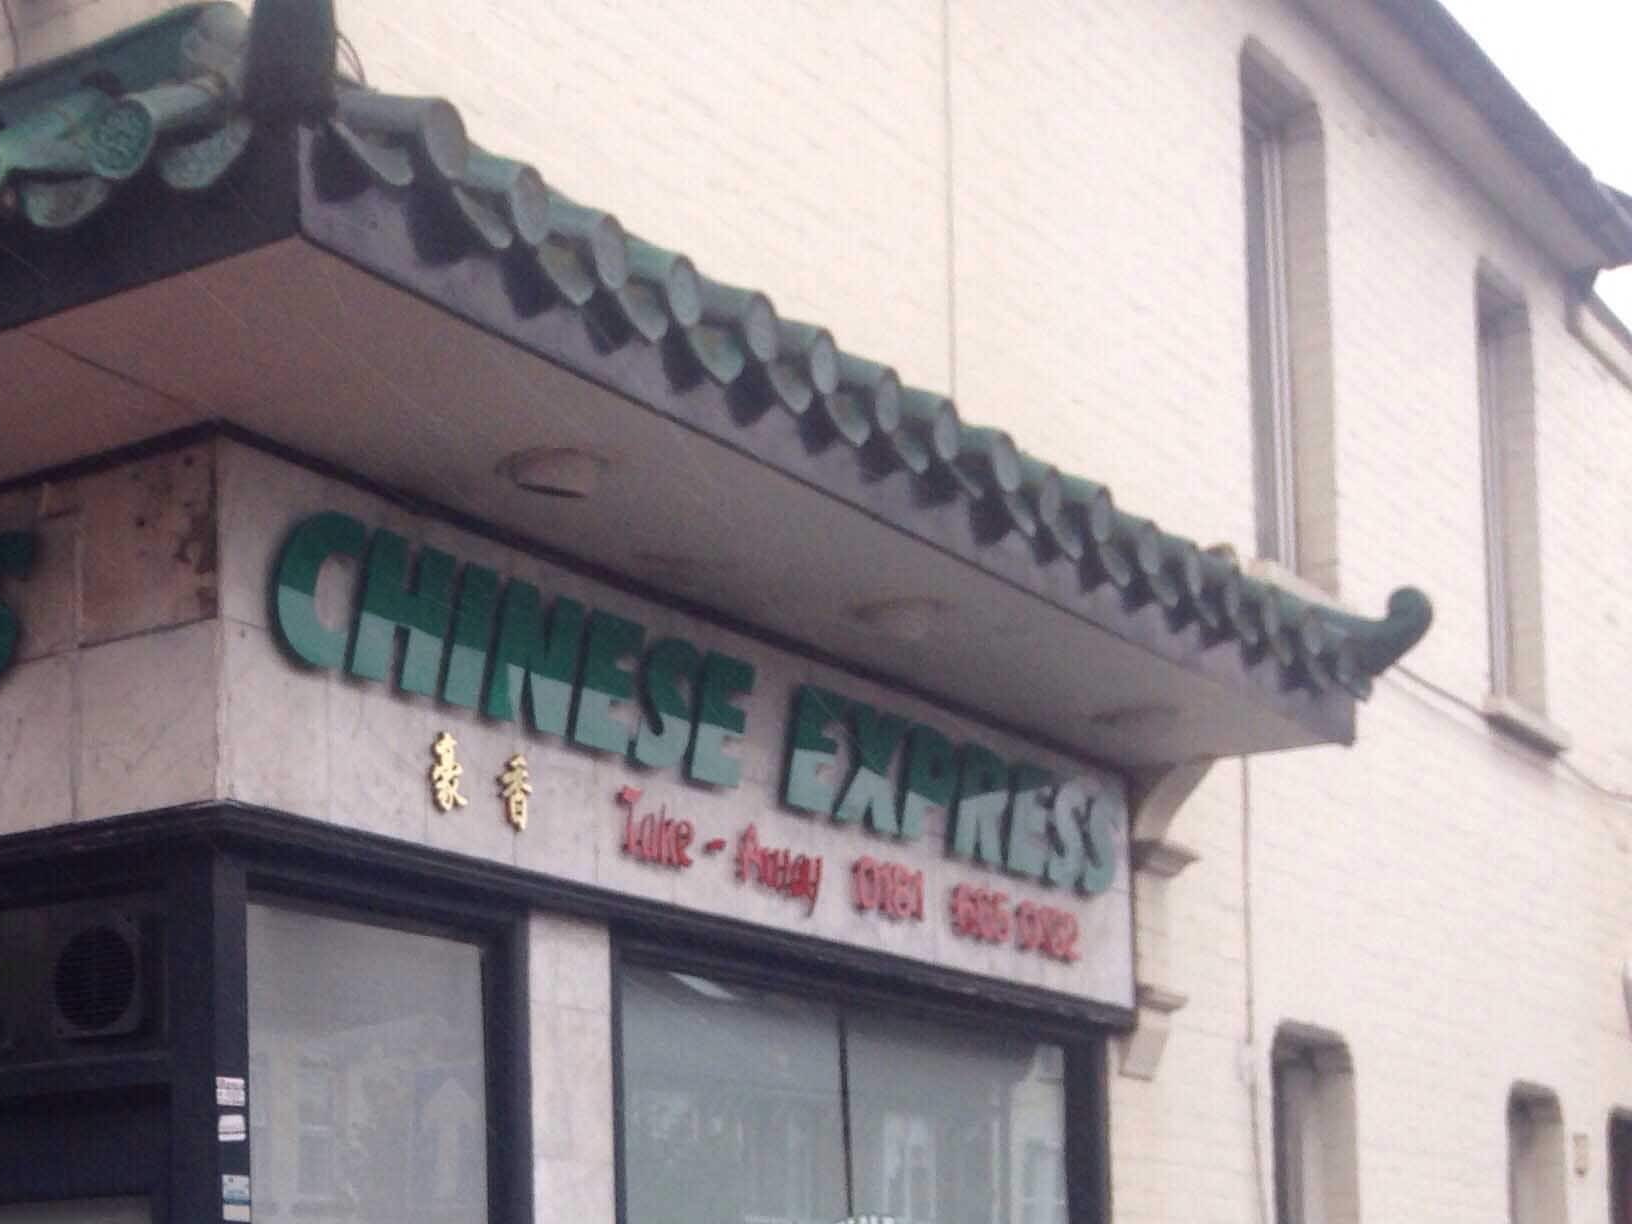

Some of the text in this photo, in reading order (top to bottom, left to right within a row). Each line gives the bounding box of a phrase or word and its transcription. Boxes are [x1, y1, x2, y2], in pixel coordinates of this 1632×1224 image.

[274, 511, 1121, 897] CHINESE EXPRESS
[617, 785, 695, 869] Take
[735, 823, 823, 917] Away
[851, 854, 925, 923] 0181
[950, 882, 1011, 945] 665
